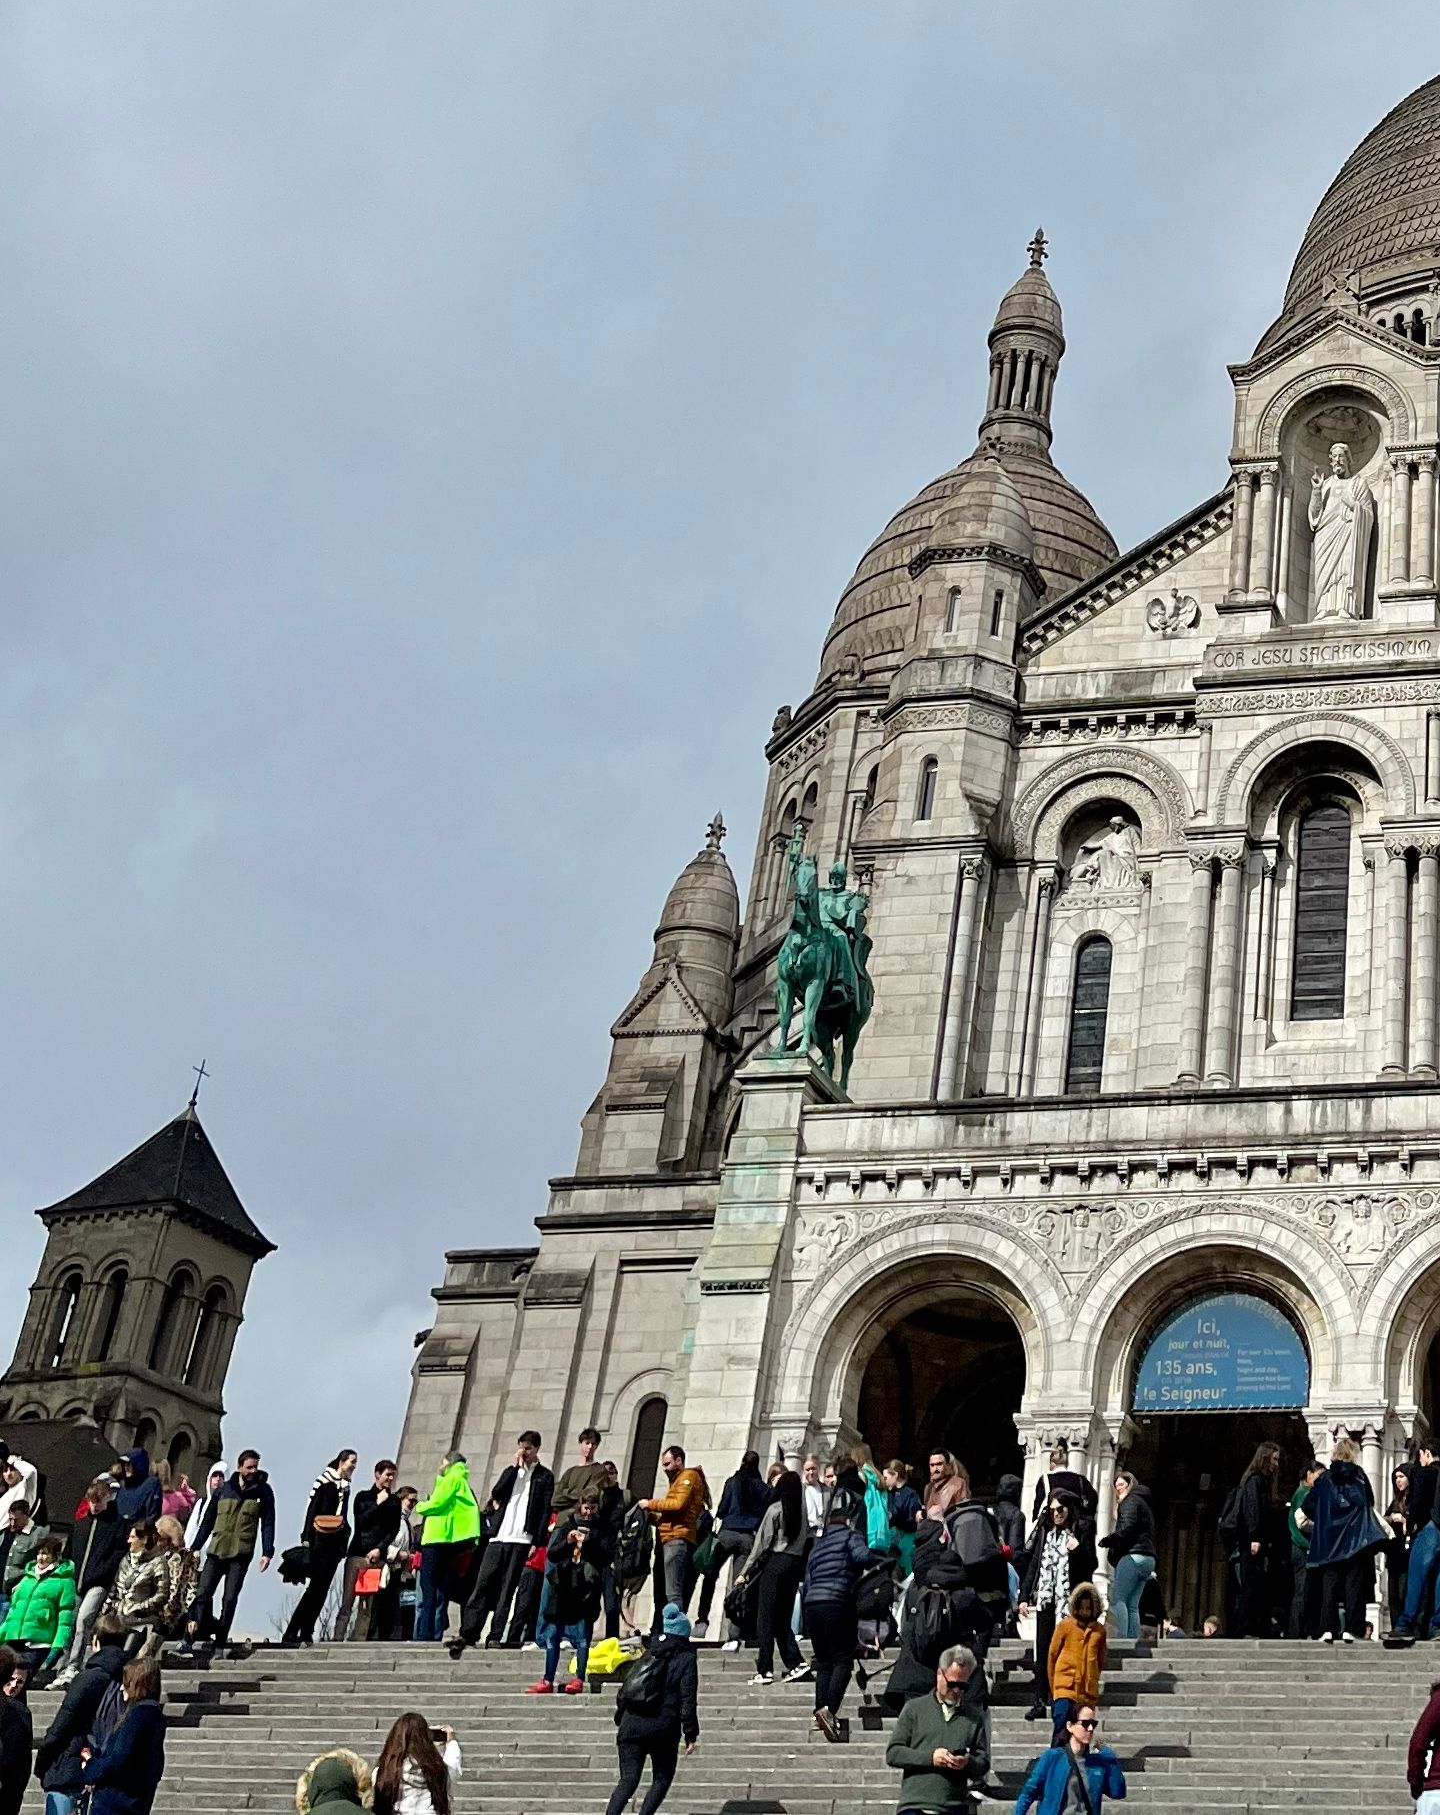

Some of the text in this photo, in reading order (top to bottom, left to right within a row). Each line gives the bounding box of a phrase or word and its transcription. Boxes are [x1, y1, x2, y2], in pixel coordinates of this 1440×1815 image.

[1213, 639, 1432, 668] COR JESU SACRATISSIMUM
[1197, 1317, 1221, 1336] Ici,
[1167, 1337, 1231, 1353] jour et nuit,
[1155, 1359, 1218, 1376] 135 ans,
[1143, 1386, 1157, 1401] le
[1161, 1386, 1227, 1404] Seigneur
